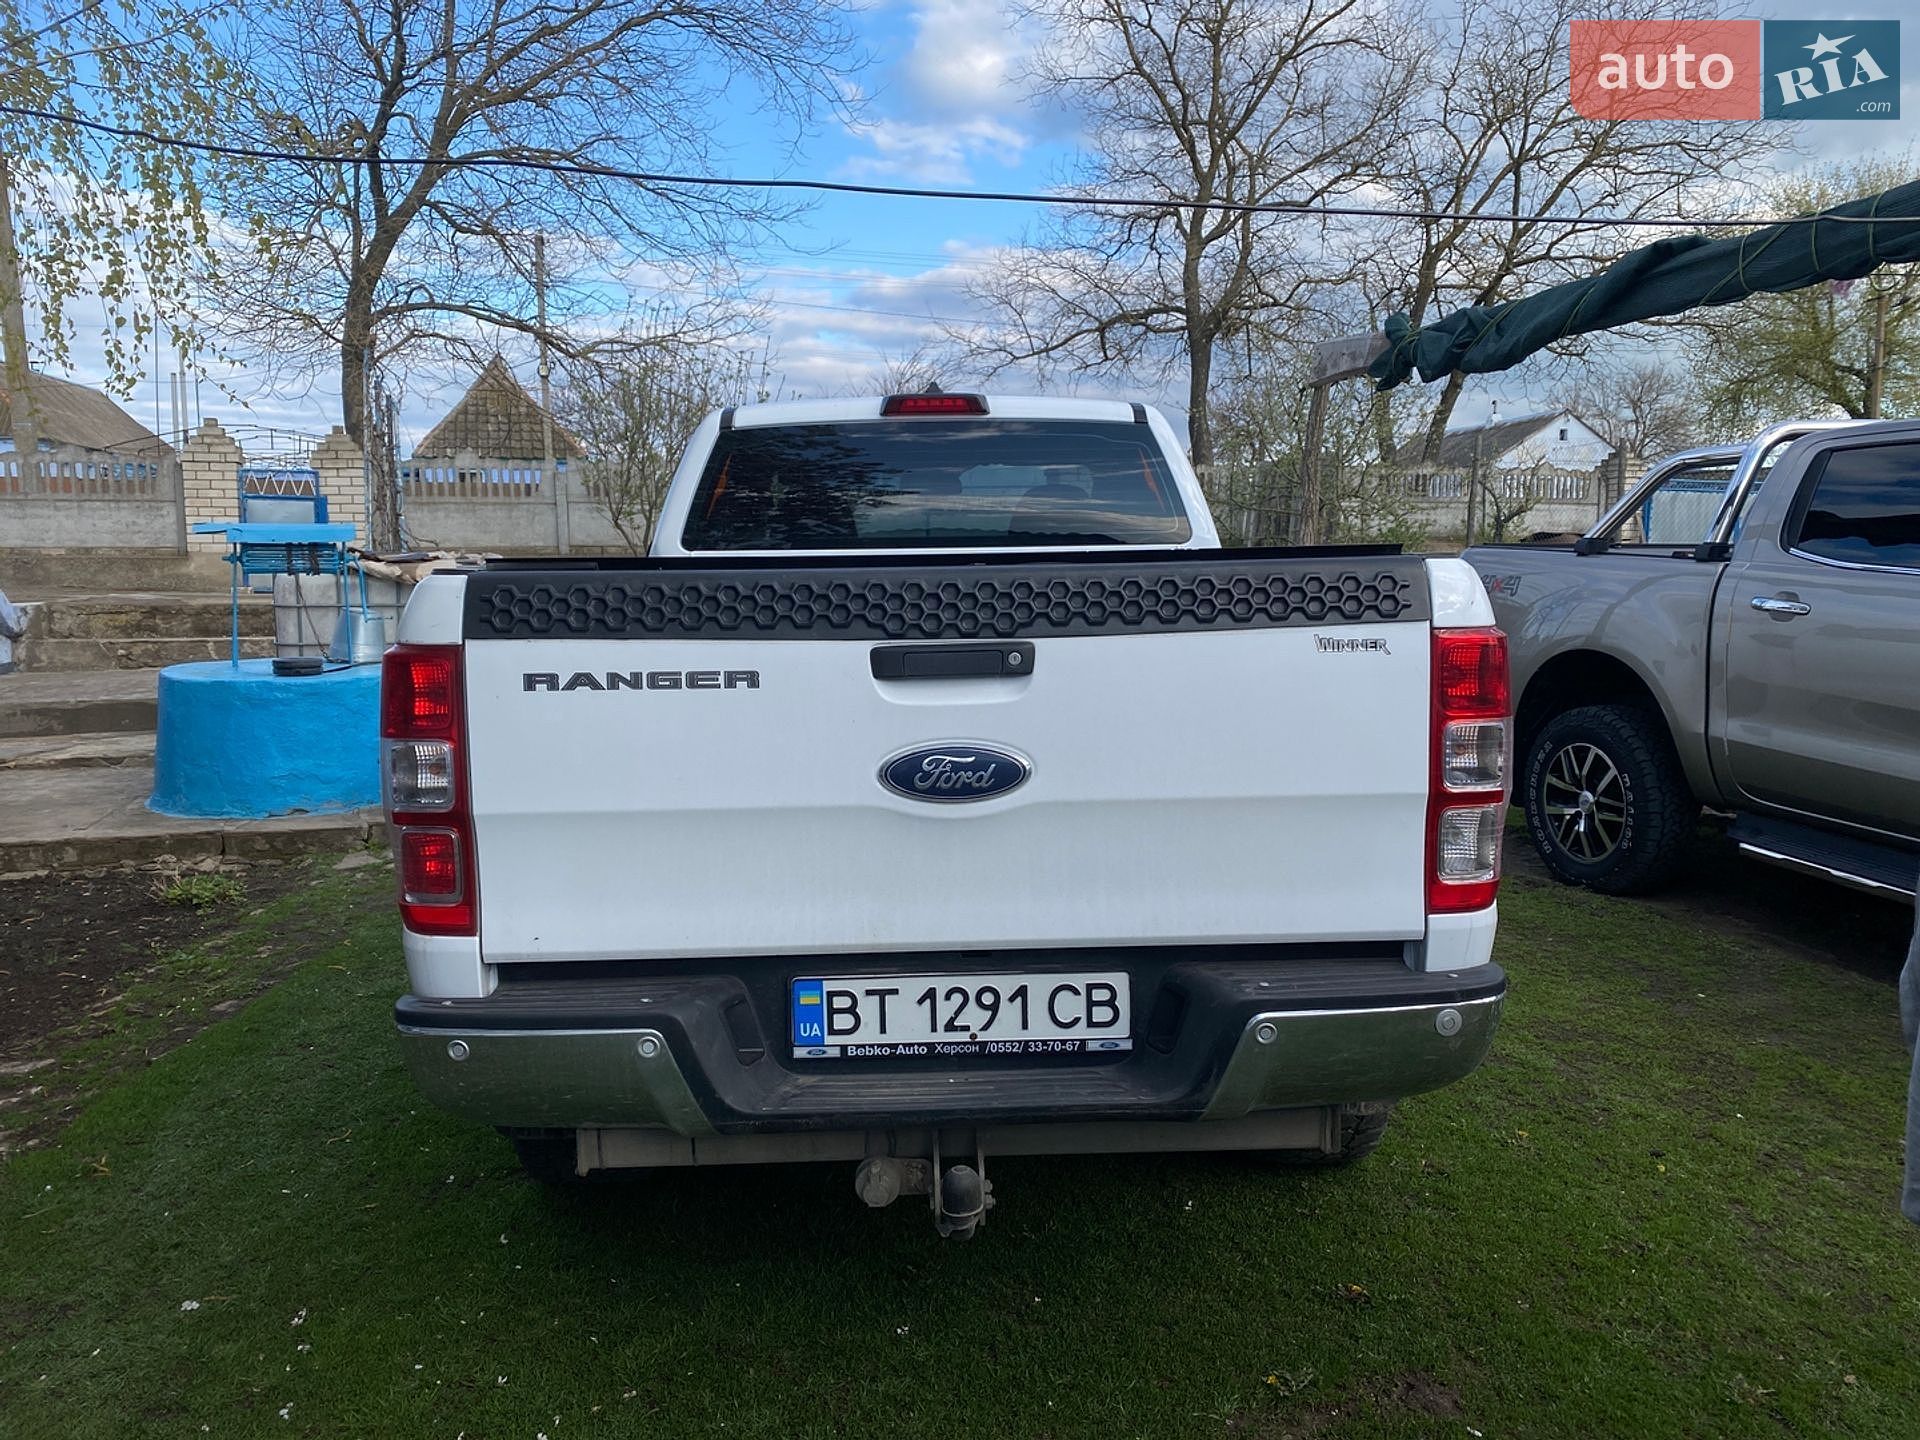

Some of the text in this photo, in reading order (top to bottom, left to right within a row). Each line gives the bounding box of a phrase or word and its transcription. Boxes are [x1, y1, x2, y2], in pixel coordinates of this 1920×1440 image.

[1314, 634, 1391, 655] WINNER
[522, 670, 761, 692] RANGER
[913, 755, 996, 790] Ford
[826, 982, 1120, 1036] BT 1291 CB
[800, 1025, 821, 1037] UA
[847, 1040, 1080, 1056] Bebko-Auto Херсон /0552/ 33-70-67
